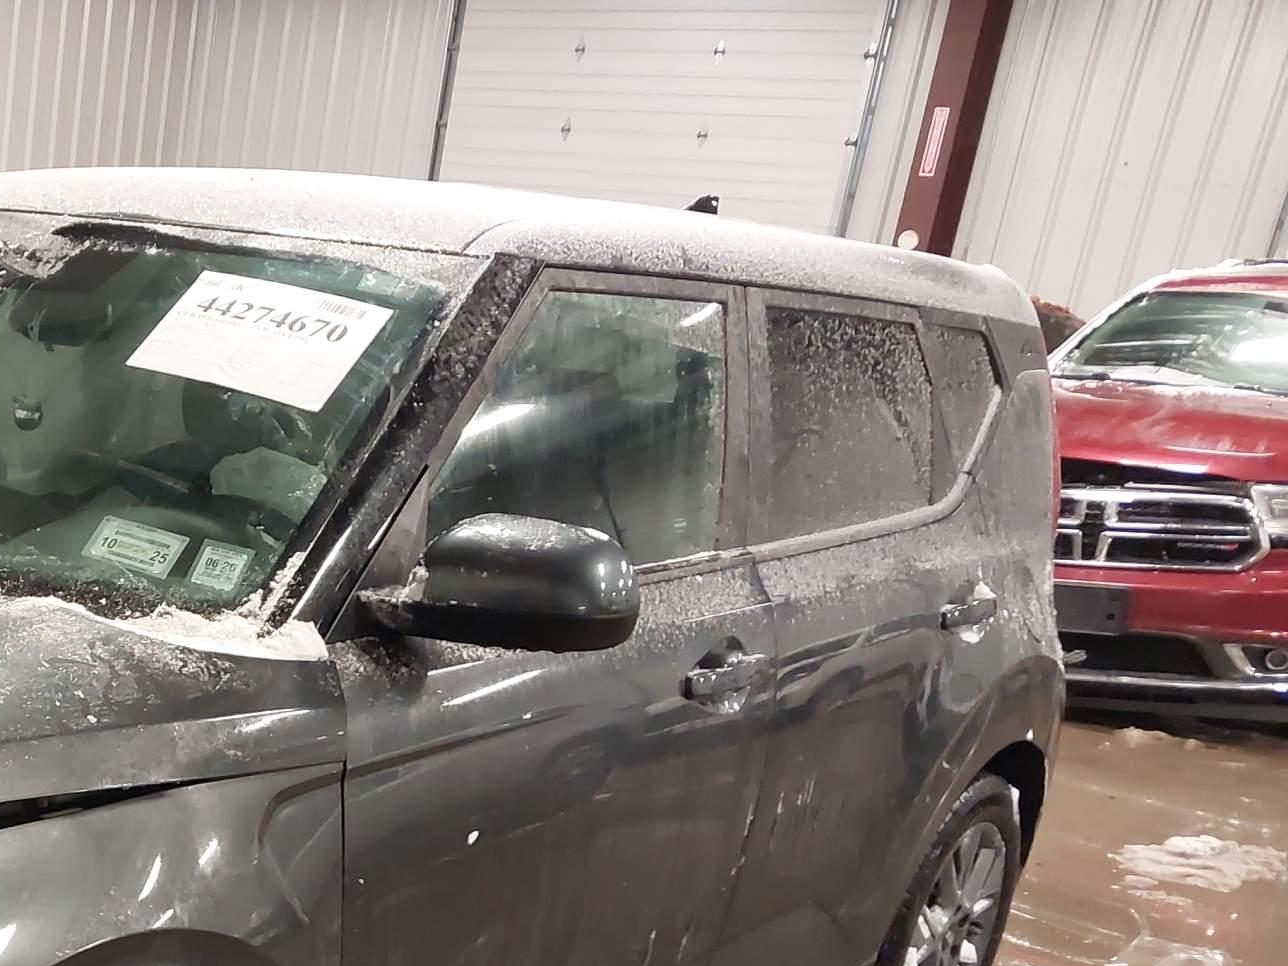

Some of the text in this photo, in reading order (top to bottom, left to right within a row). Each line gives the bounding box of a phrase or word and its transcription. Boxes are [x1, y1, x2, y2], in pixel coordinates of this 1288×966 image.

[197, 296, 349, 343] 44274670
[101, 536, 118, 549] 10
[149, 551, 170, 564] 25
